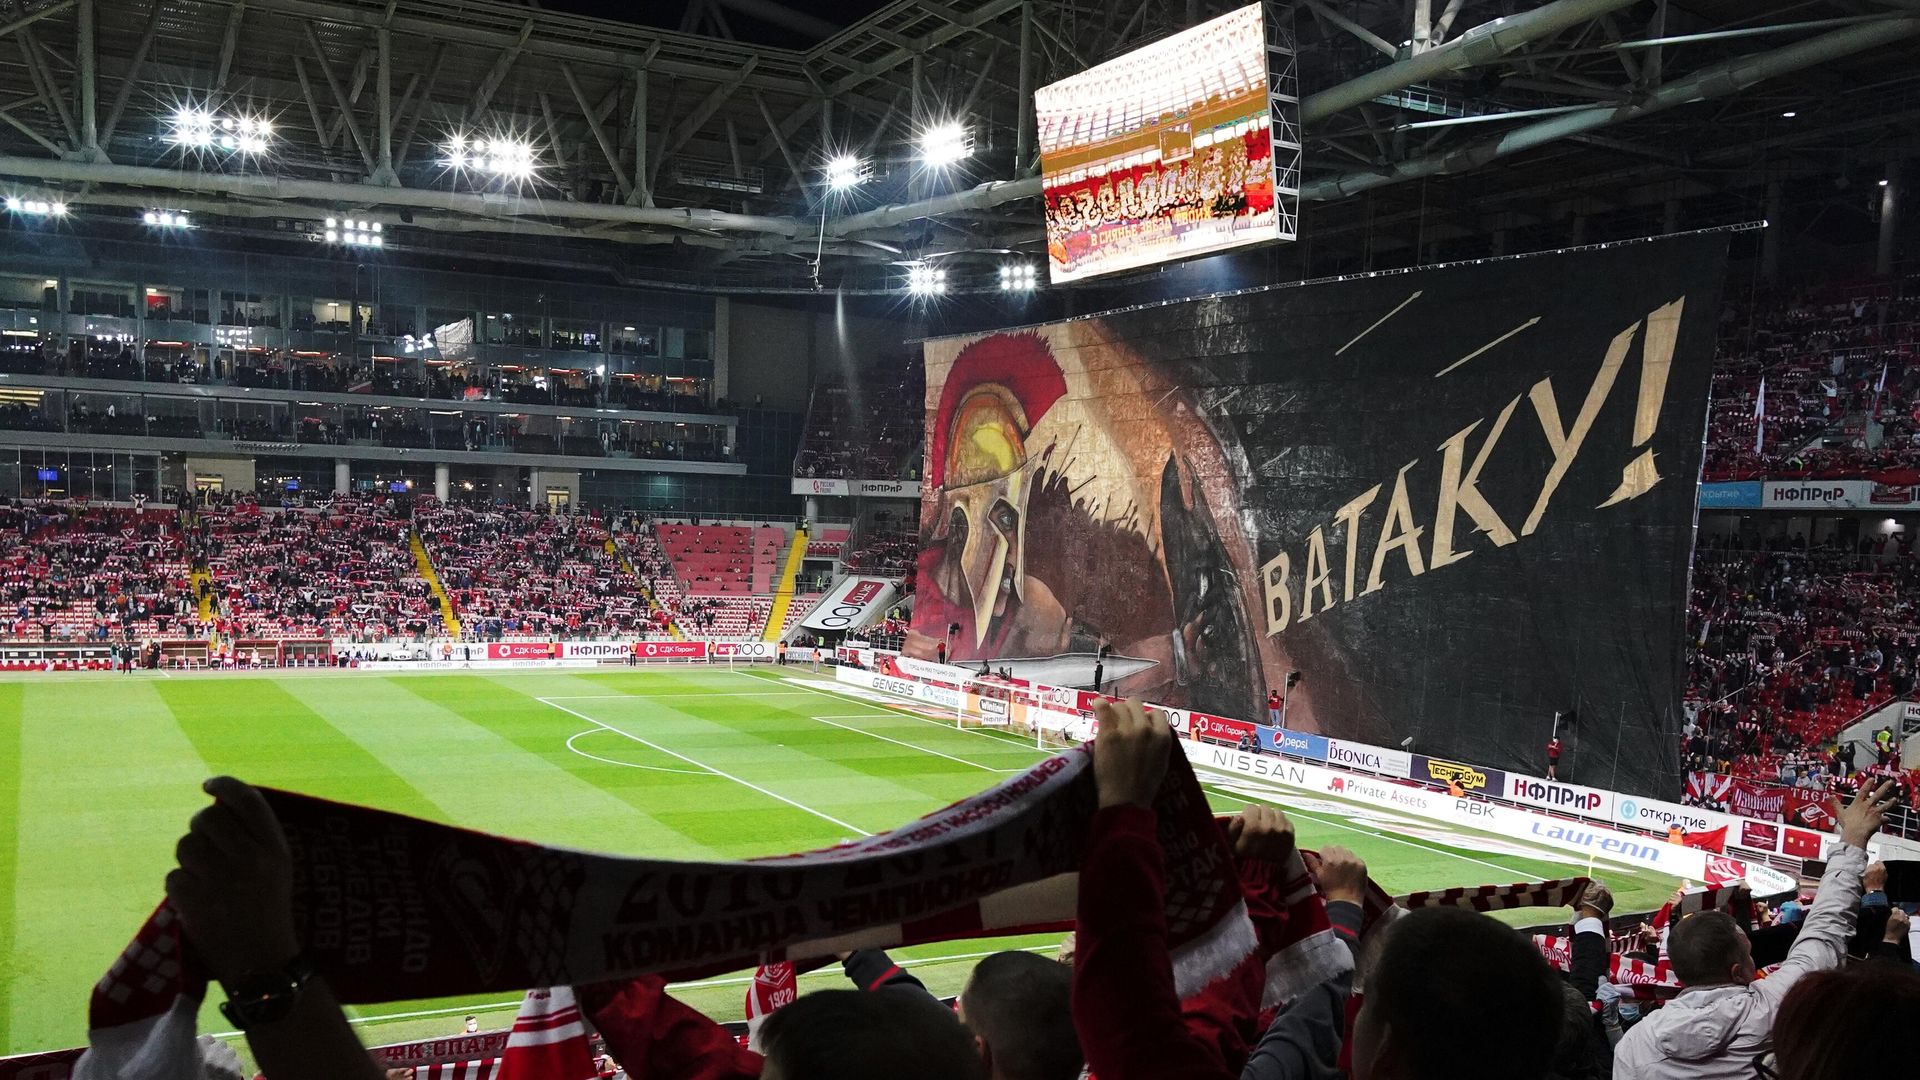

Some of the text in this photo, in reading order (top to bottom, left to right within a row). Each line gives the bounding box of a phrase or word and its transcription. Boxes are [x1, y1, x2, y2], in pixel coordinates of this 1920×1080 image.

[513, 647, 529, 655] СДК
[872, 677, 915, 696] GENESIS
[1210, 722, 1225, 733] СДК
[1285, 736, 1309, 750] pepsi
[1213, 750, 1305, 784] NISSAN
[1329, 746, 1382, 769] DEONICA
[1347, 779, 1428, 809] Private Assets
[1514, 778, 1602, 811] НФПРиР
[1790, 787, 1830, 802] ТВЕР
[1455, 799, 1496, 819] RBK
[1640, 807, 1707, 830] откртие
[767, 988, 795, 1010] 1922
[433, 1034, 509, 1057] СПАРТ
